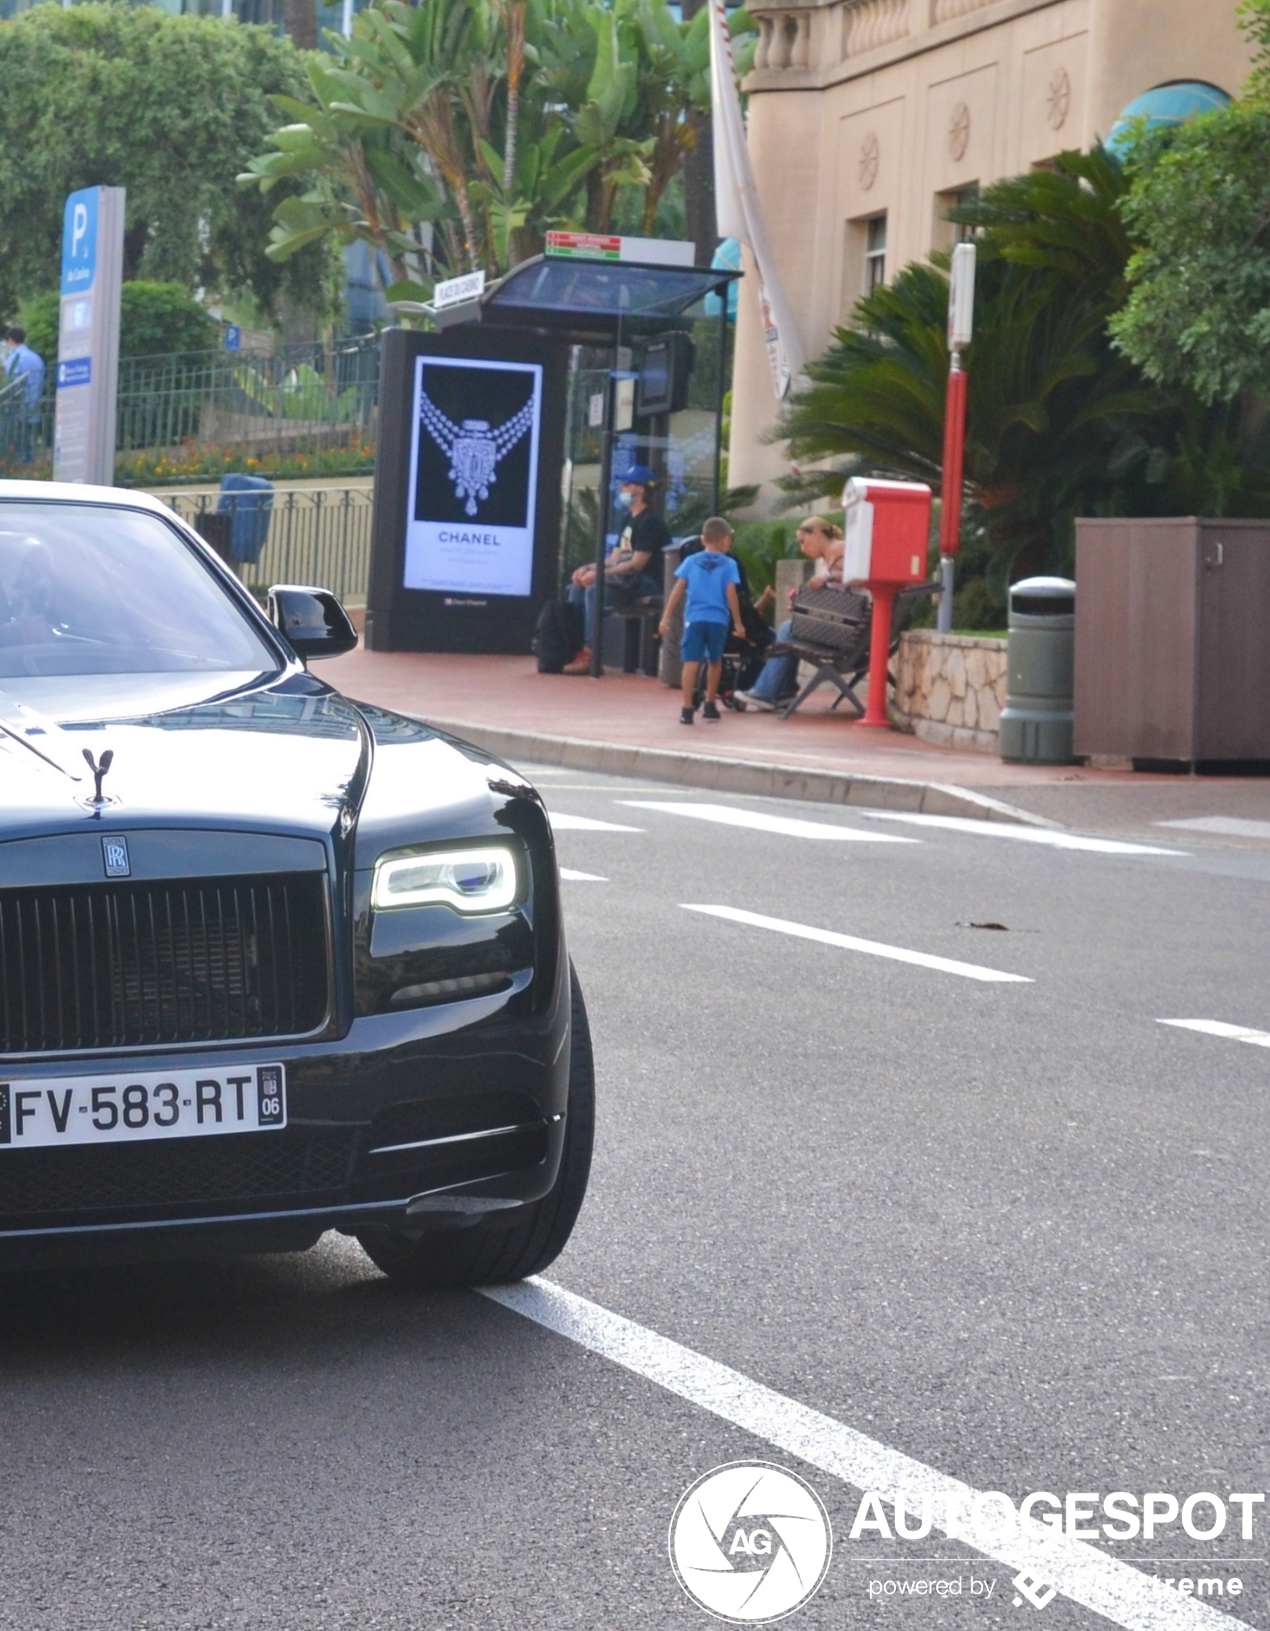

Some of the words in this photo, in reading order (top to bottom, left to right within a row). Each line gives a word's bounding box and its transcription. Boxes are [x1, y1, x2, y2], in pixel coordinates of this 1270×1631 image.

[72, 203, 88, 258] P
[438, 531, 501, 546] CHANEL
[15, 1076, 252, 1136] FV-583-RT
[262, 1097, 280, 1116] 06
